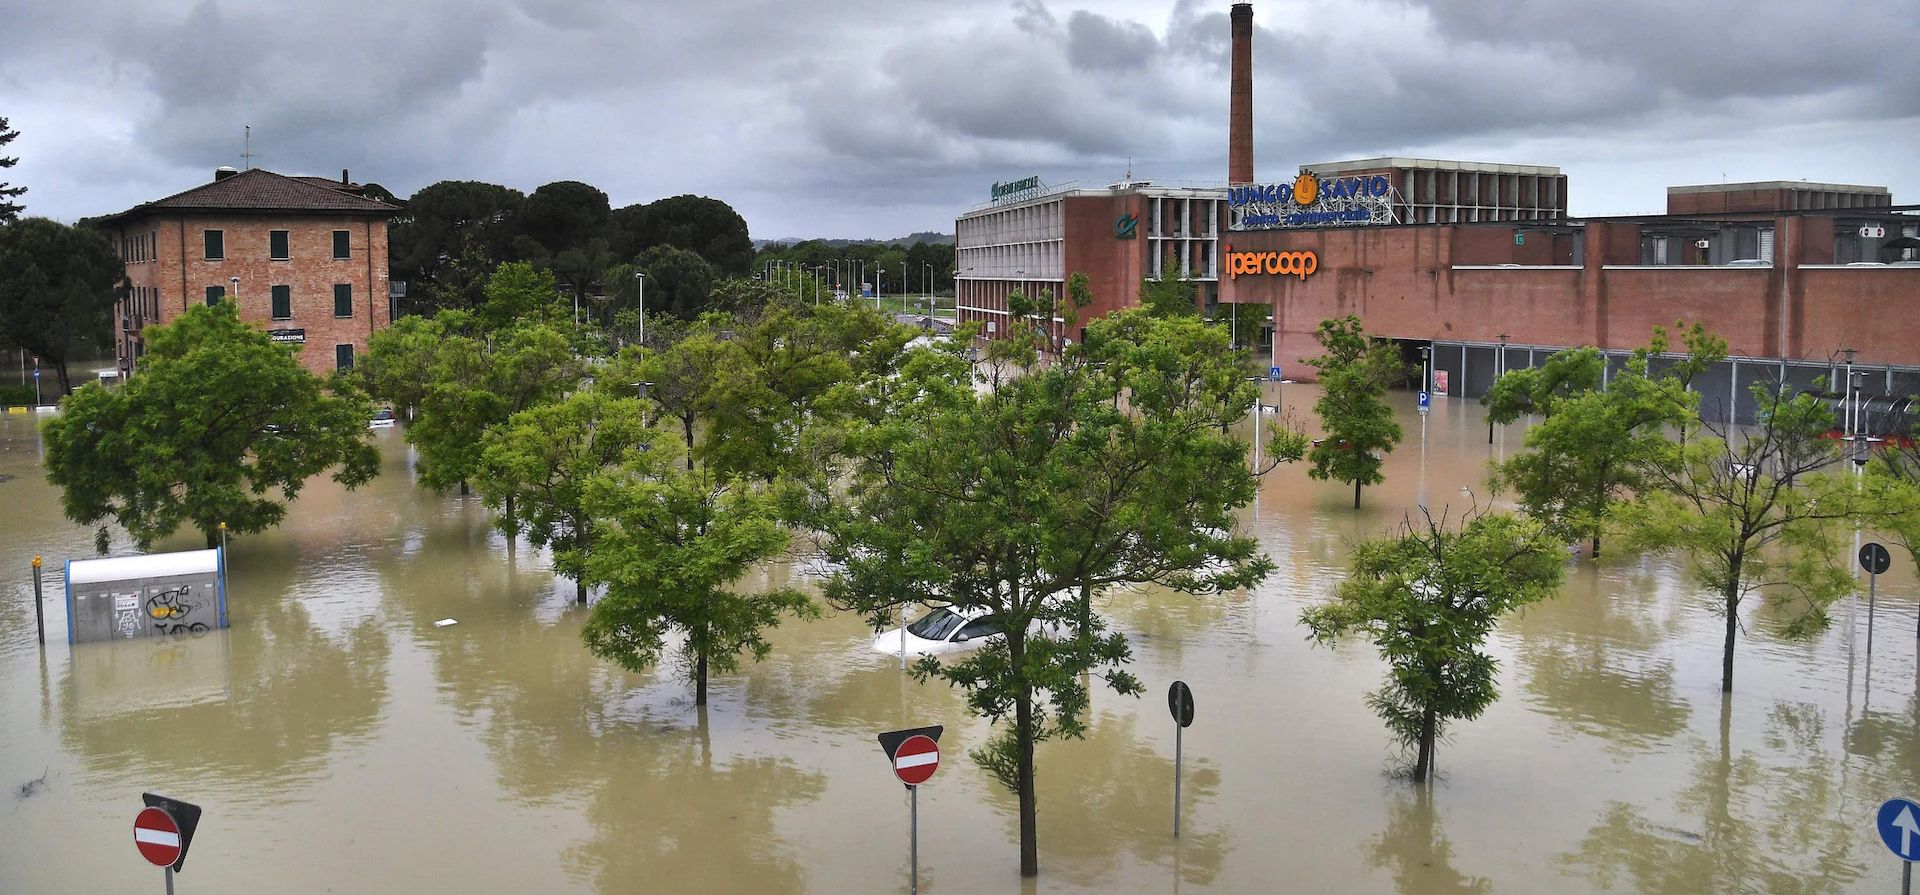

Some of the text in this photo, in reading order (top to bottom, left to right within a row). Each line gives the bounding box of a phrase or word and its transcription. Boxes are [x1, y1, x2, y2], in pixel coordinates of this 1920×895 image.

[1228, 175, 1388, 206] LUNGO SAVIO
[1225, 244, 1318, 280] ipercoop
[1419, 392, 1427, 404] P
